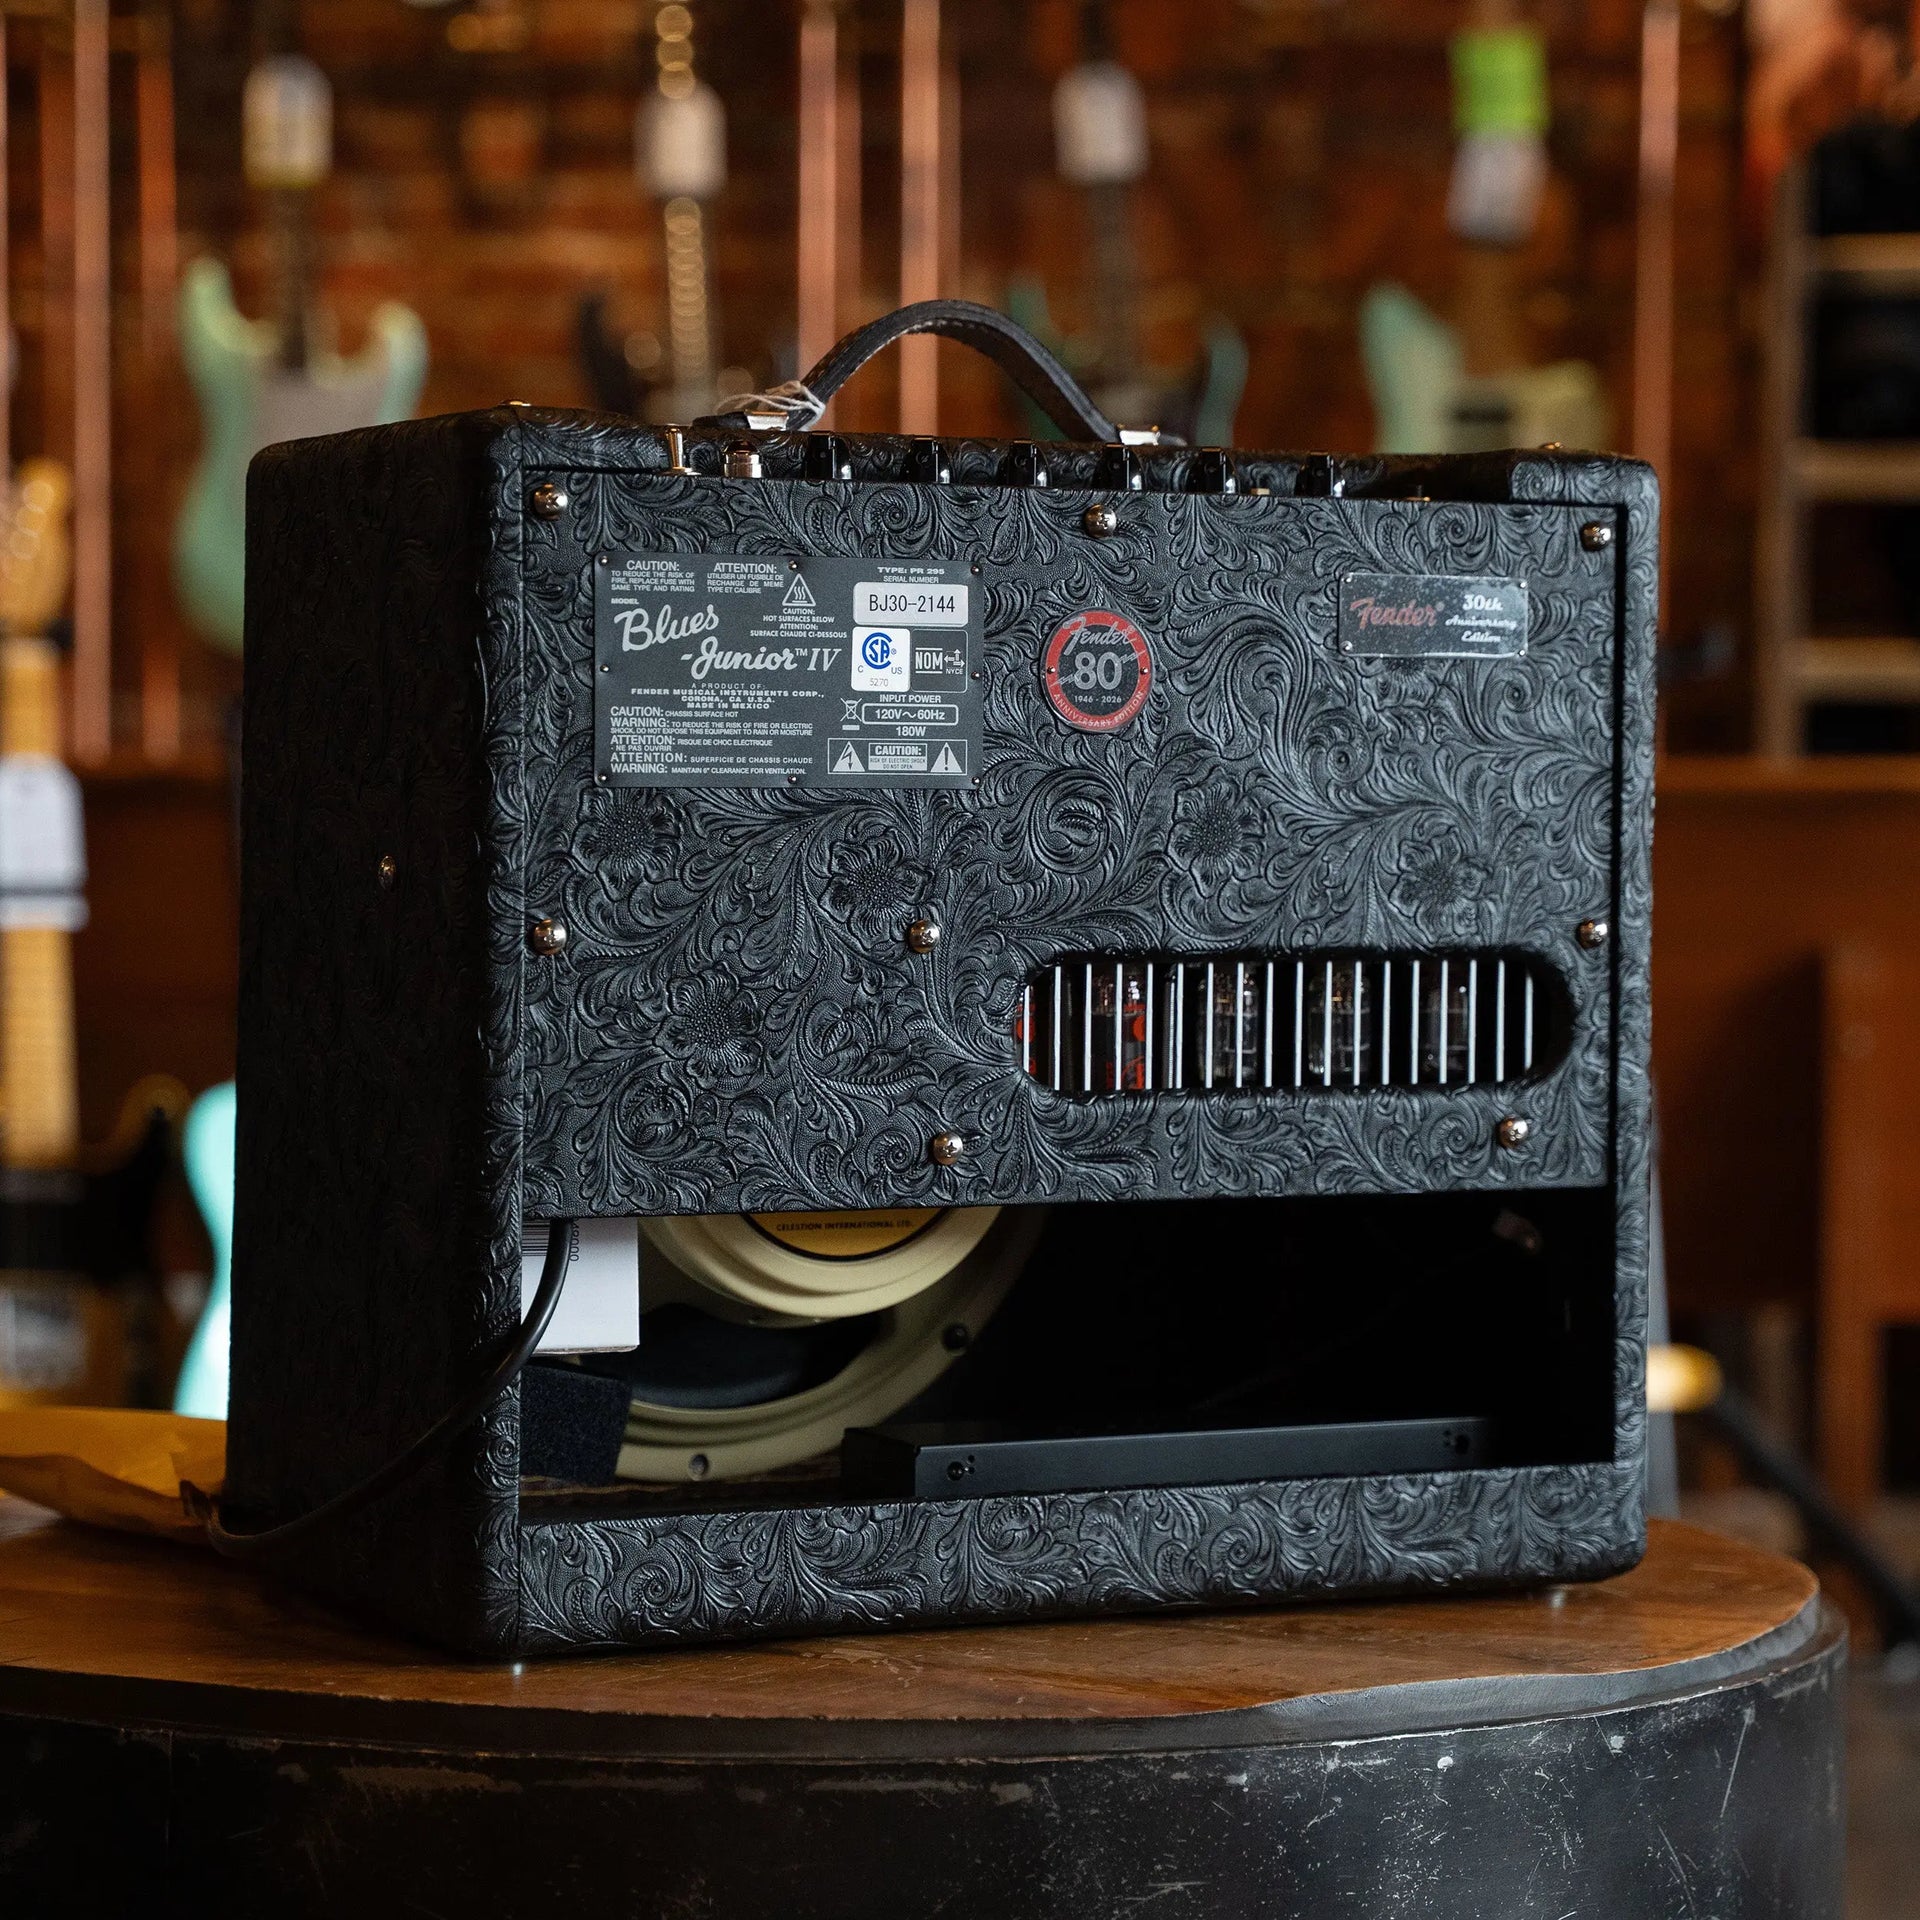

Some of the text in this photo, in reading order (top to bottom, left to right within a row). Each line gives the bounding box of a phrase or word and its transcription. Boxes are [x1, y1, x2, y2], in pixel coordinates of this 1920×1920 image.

[627, 560, 680, 571] CAUTION:
[714, 562, 777, 574] ATTENTION:
[869, 594, 956, 612] BJ30-2144
[1462, 594, 1503, 610] 30th
[614, 604, 719, 652] Blues
[1445, 615, 1517, 630] Anniversary
[1461, 630, 1502, 642] Edition
[807, 648, 842, 671] IV
[916, 652, 943, 670] NOM
[1075, 652, 1122, 690] 80
[908, 695, 942, 703] POWER
[610, 706, 664, 716] CAUTION:
[1054, 690, 1144, 727] ANNIVERSARY EDITION
[610, 718, 670, 728] WARNING:
[896, 726, 926, 736] 180W
[610, 734, 675, 744] ATTENTION:
[875, 746, 922, 756] CAUTION:
[610, 752, 687, 762] ATTENTION:
[610, 764, 668, 773] WARNING:
[776, 1223, 822, 1232] CELESTION
[825, 1221, 893, 1230] INTERNATIONAL
